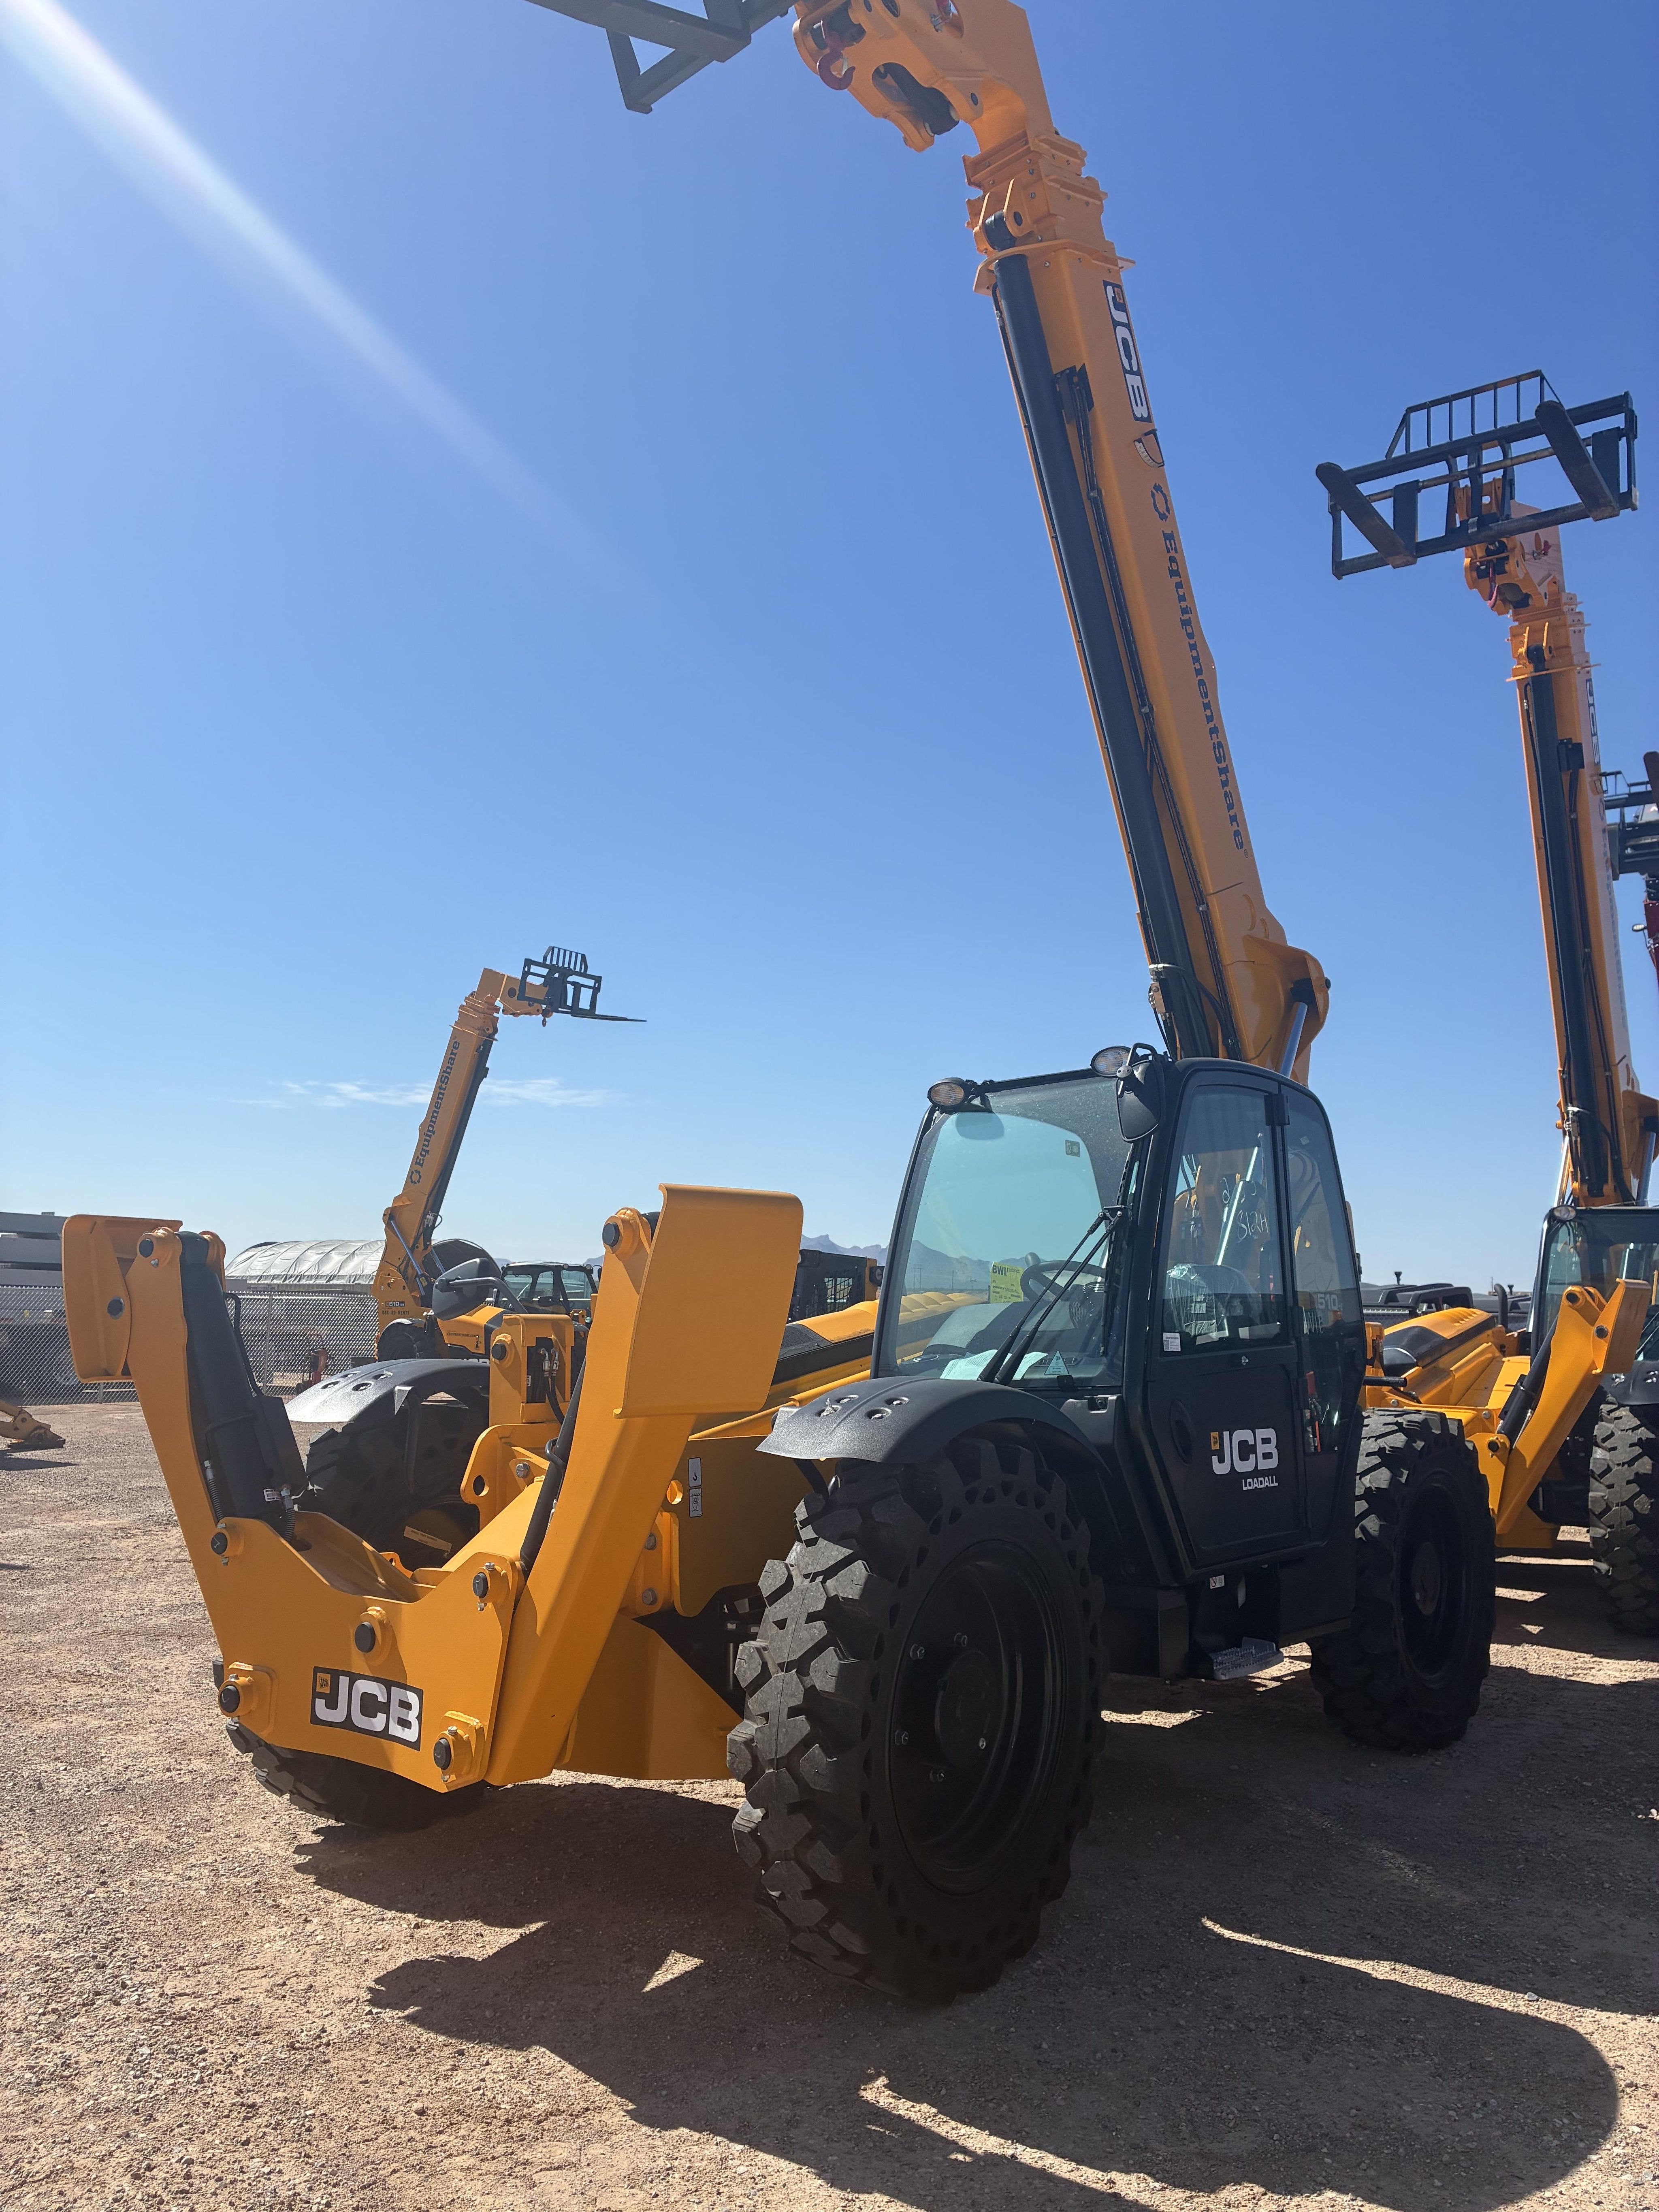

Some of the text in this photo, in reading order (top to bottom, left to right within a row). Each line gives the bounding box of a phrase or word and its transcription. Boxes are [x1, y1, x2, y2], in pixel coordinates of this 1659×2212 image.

[1106, 285, 1149, 418] JCB
[1162, 530, 1244, 851] EquipmentShare
[1587, 681, 1599, 764] JCB
[415, 1040, 460, 1168] EquipmentShare
[1212, 1428, 1279, 1474] JCB
[1242, 1475, 1278, 1491] LOADALL
[315, 1675, 420, 1742] JCB
